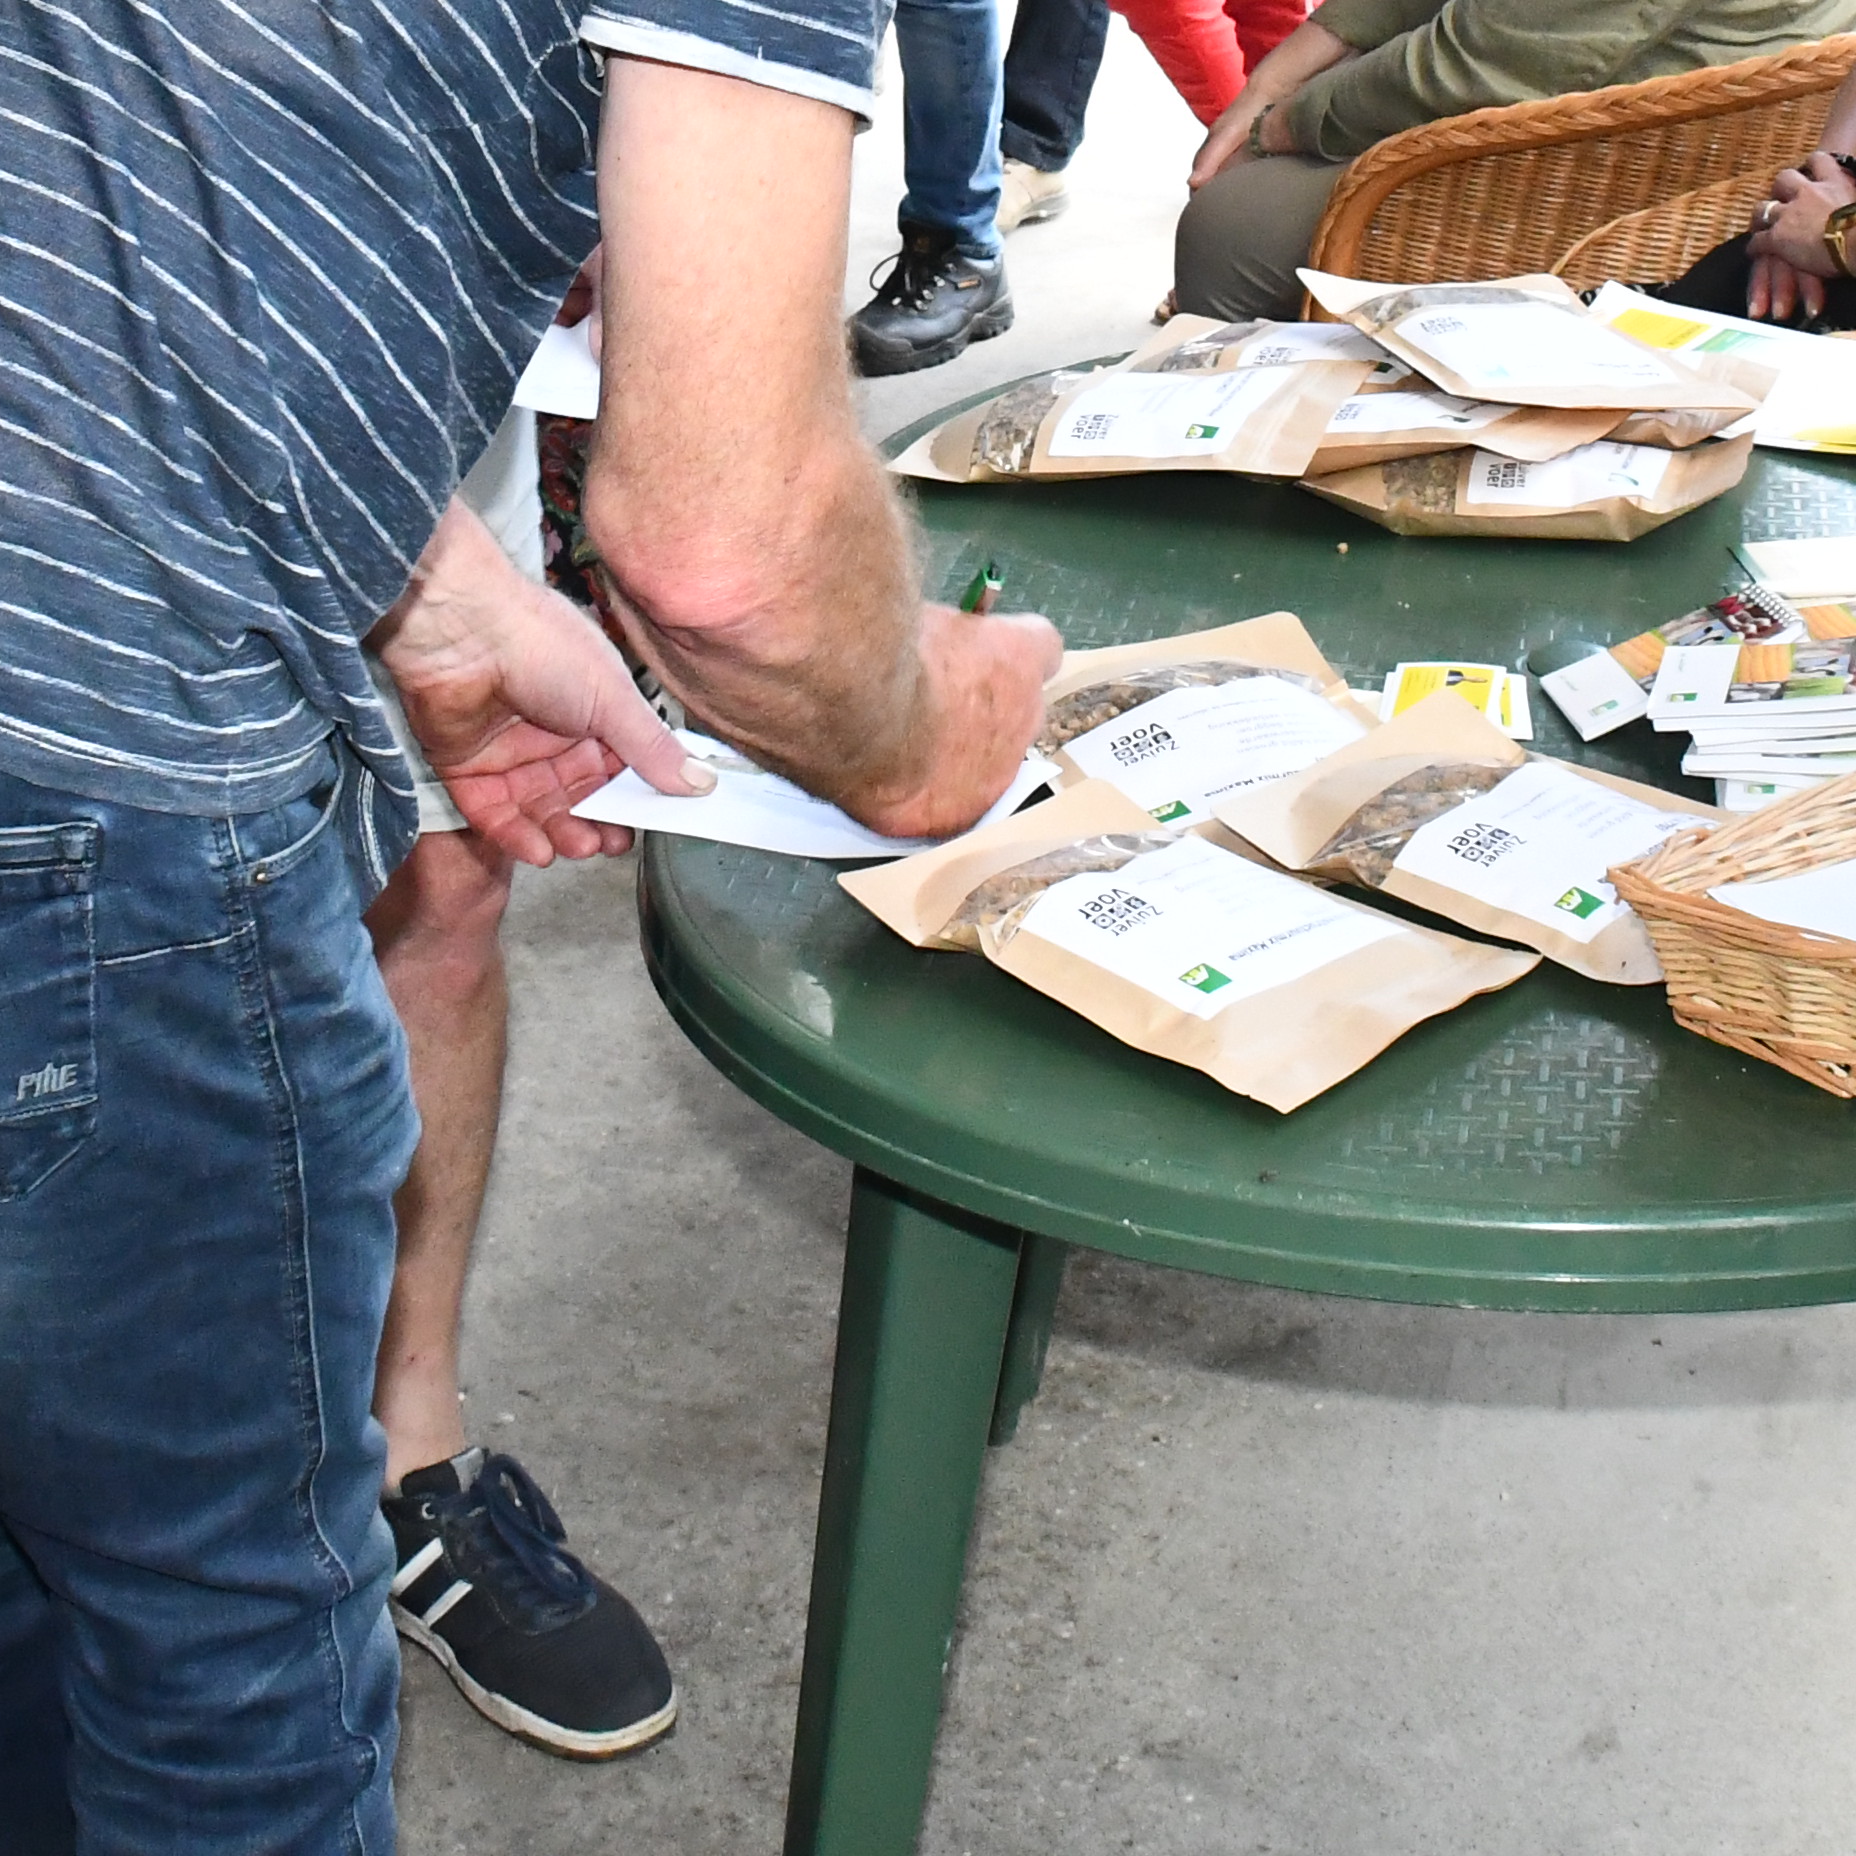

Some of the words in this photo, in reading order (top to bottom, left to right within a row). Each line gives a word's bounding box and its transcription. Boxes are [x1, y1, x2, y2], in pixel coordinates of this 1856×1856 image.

[1070, 413, 1092, 440] voer
[1486, 463, 1501, 488] voer
[1110, 722, 1164, 751] voer
[1123, 740, 1180, 767] Zuiver
[1447, 823, 1493, 854] voer
[1480, 835, 1528, 867] Zuiver
[1078, 888, 1130, 919] voer
[1111, 905, 1164, 937] Zuiver
